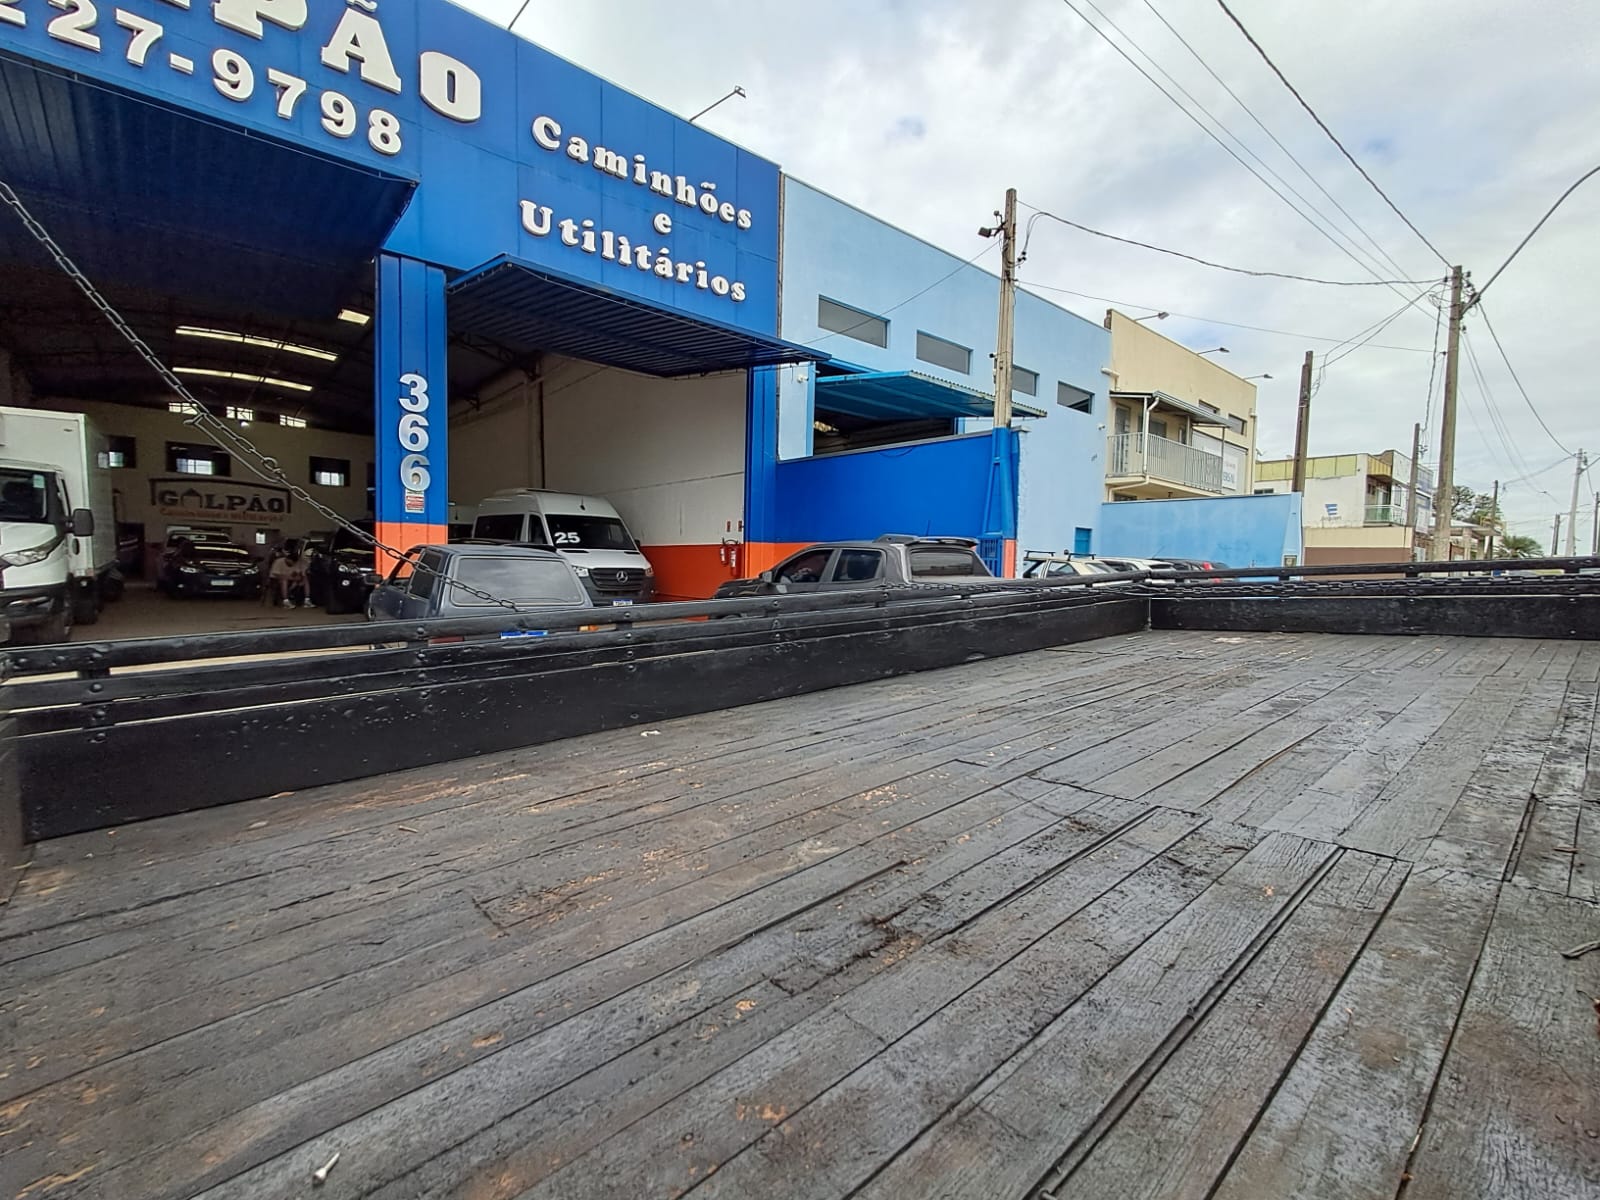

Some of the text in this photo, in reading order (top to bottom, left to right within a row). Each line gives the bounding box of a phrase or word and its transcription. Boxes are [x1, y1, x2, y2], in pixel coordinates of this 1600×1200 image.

[153, 0, 482, 123] PÃO
[531, 115, 752, 230] Caminhões
[653, 212, 673, 234] e
[519, 199, 746, 302] Utilitários
[398, 372, 431, 492] 366
[554, 531, 581, 544] 25
